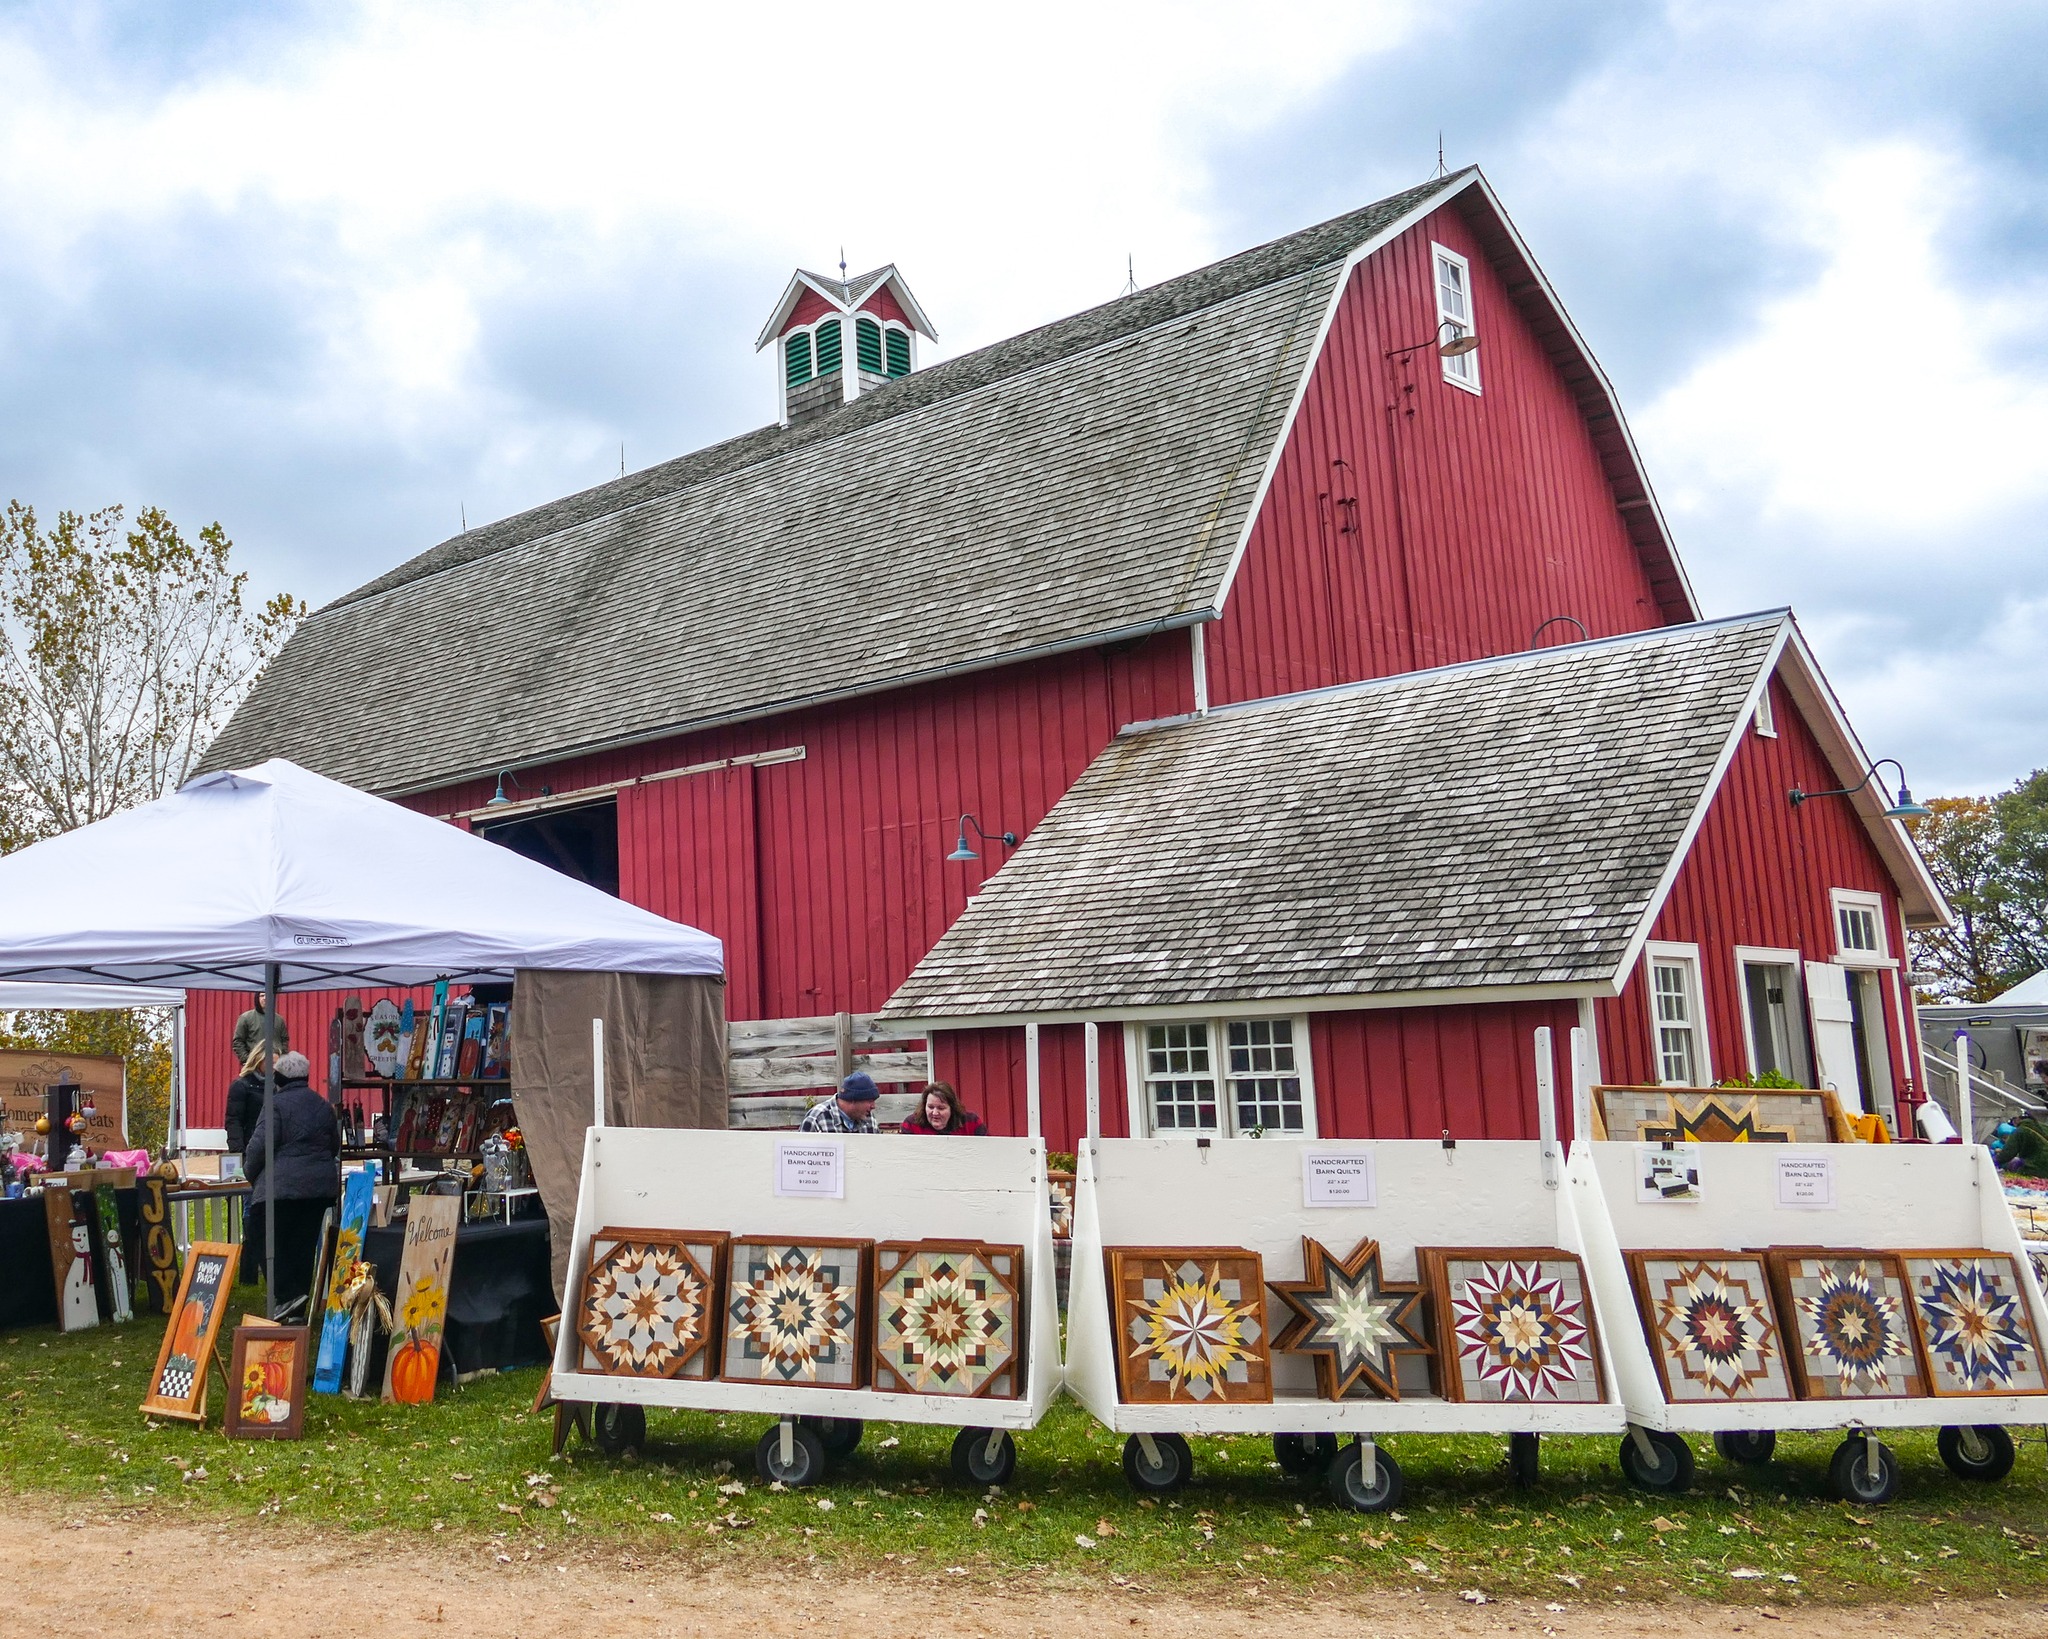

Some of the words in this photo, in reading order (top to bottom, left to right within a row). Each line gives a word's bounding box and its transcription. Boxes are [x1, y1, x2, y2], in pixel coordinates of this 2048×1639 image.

[14, 1083, 39, 1097] AK'S
[89, 1115, 114, 1128] eats
[408, 1215, 454, 1246] Welcome
[143, 1180, 177, 1314] JOY
